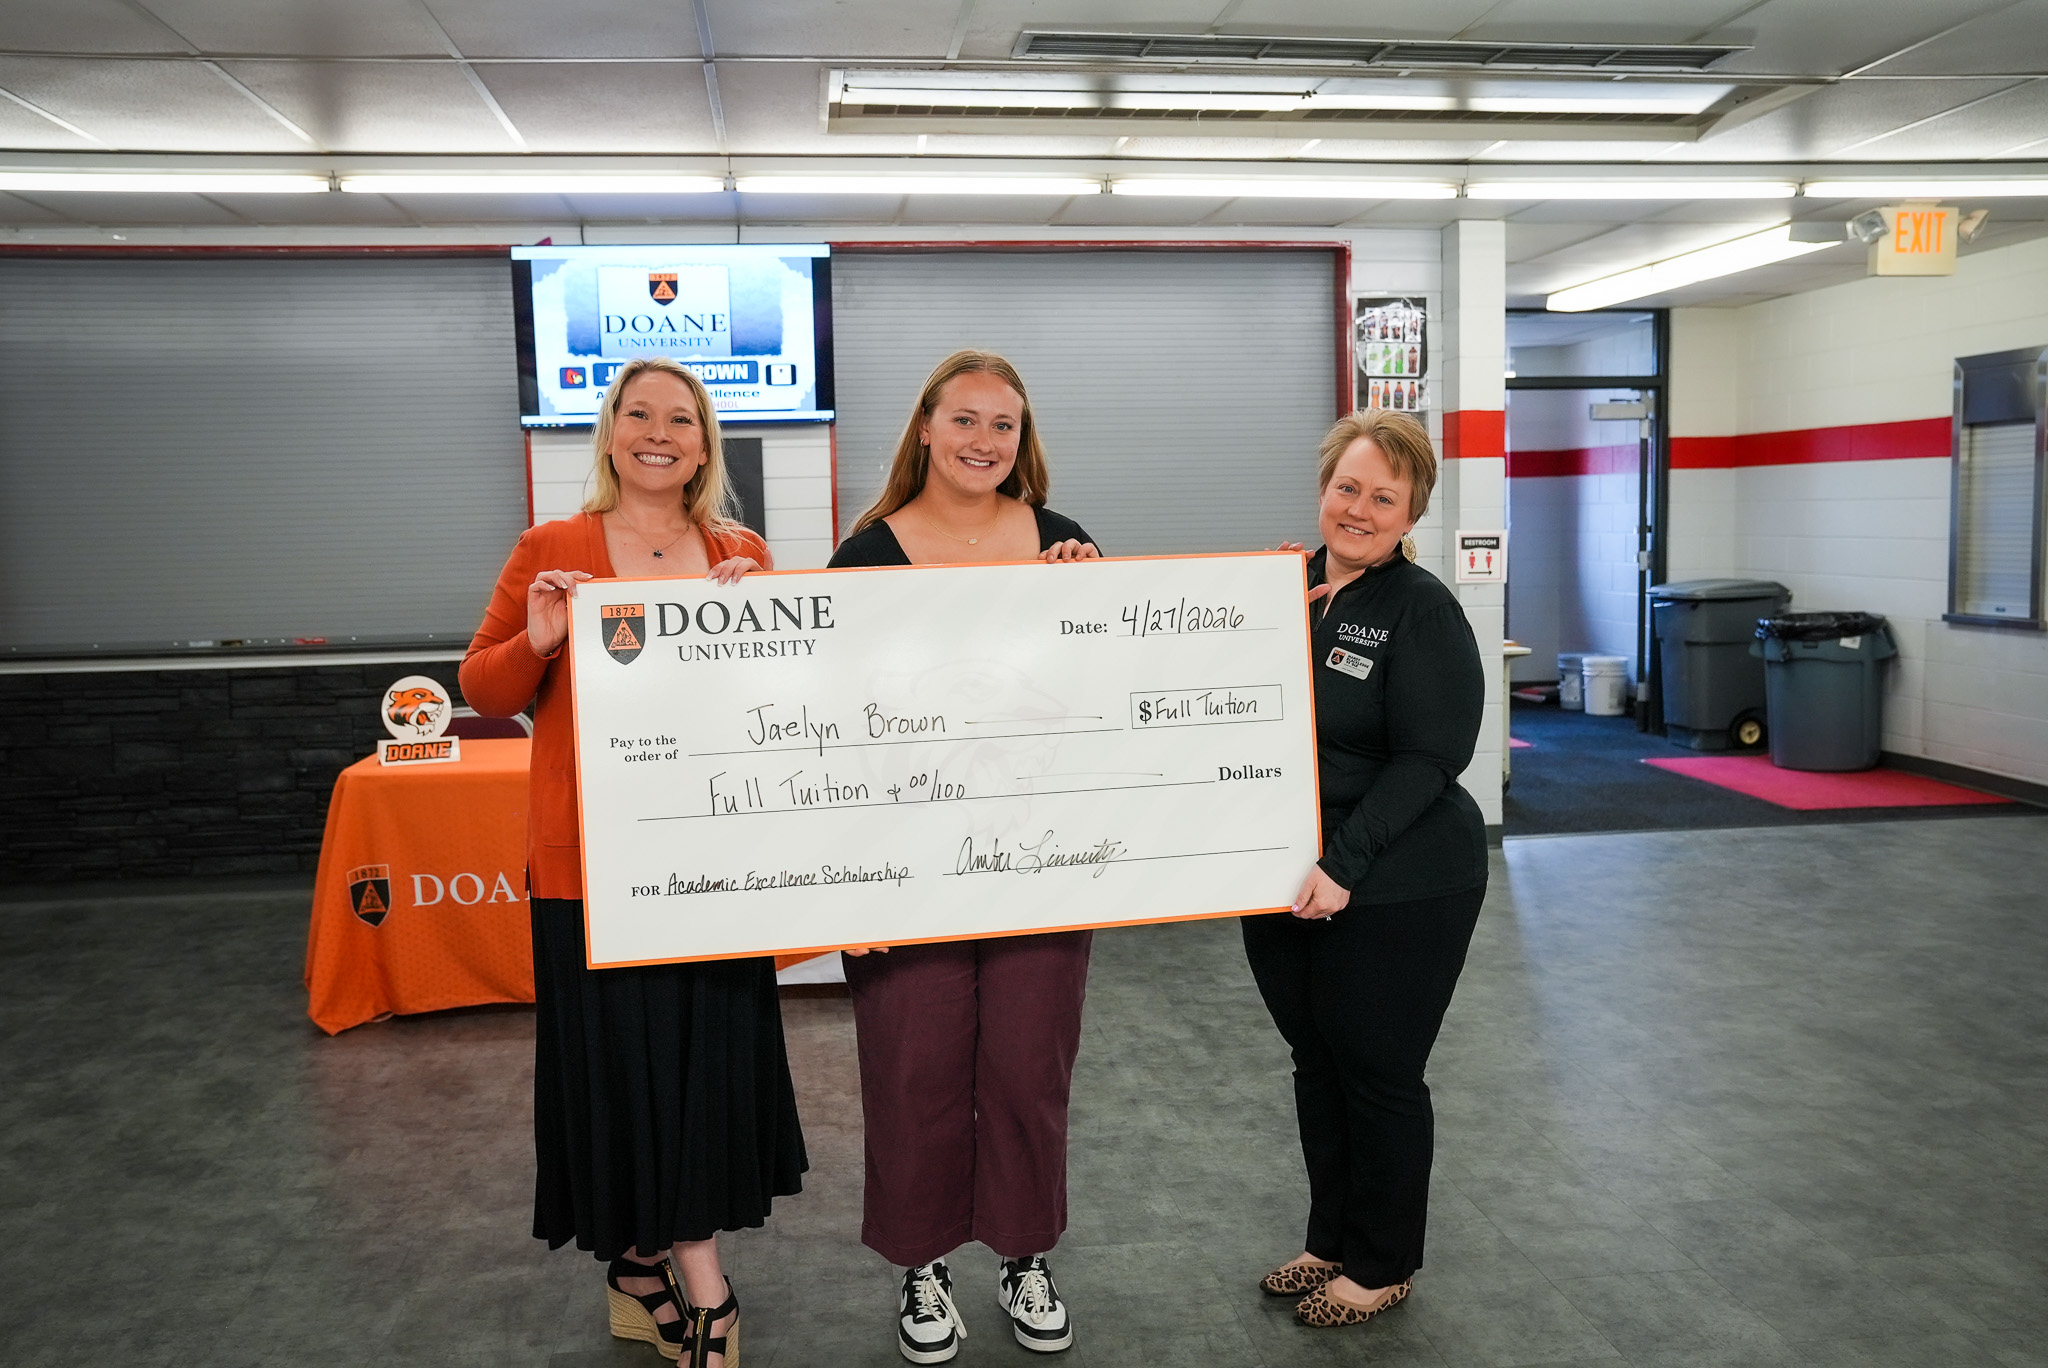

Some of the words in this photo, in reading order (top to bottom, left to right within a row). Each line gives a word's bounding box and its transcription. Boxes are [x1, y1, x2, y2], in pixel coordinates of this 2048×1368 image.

[1895, 212, 1947, 253] EXIT
[604, 314, 727, 334] DOANE
[618, 337, 714, 347] UNIVERSITY
[683, 364, 748, 381] ROWN
[608, 606, 637, 617] 1872
[655, 596, 835, 637] DOANE
[1060, 620, 1109, 635] Date:
[1122, 597, 1245, 638] 4/27/2026
[1337, 622, 1389, 642] DOANE
[1338, 634, 1380, 648] UNIVERSITY
[677, 639, 817, 662] UNIVERSITY
[1196, 691, 1258, 716] Tuition
[747, 703, 840, 757] Jaelyn
[863, 703, 946, 739] Brown
[386, 741, 453, 762] DOANE
[610, 737, 635, 750] Pay
[638, 736, 652, 747] to
[655, 735, 677, 746] the
[624, 751, 661, 763] order
[665, 749, 679, 761] of
[1218, 765, 1283, 781] Dollars
[709, 772, 763, 816] Full
[779, 770, 869, 805] Tuition
[354, 867, 381, 881] 1872
[668, 872, 739, 897] Academic
[744, 870, 818, 892] Excellence
[822, 862, 910, 888] Scholarship
[411, 869, 530, 906] DOA
[631, 886, 661, 897] FOR
